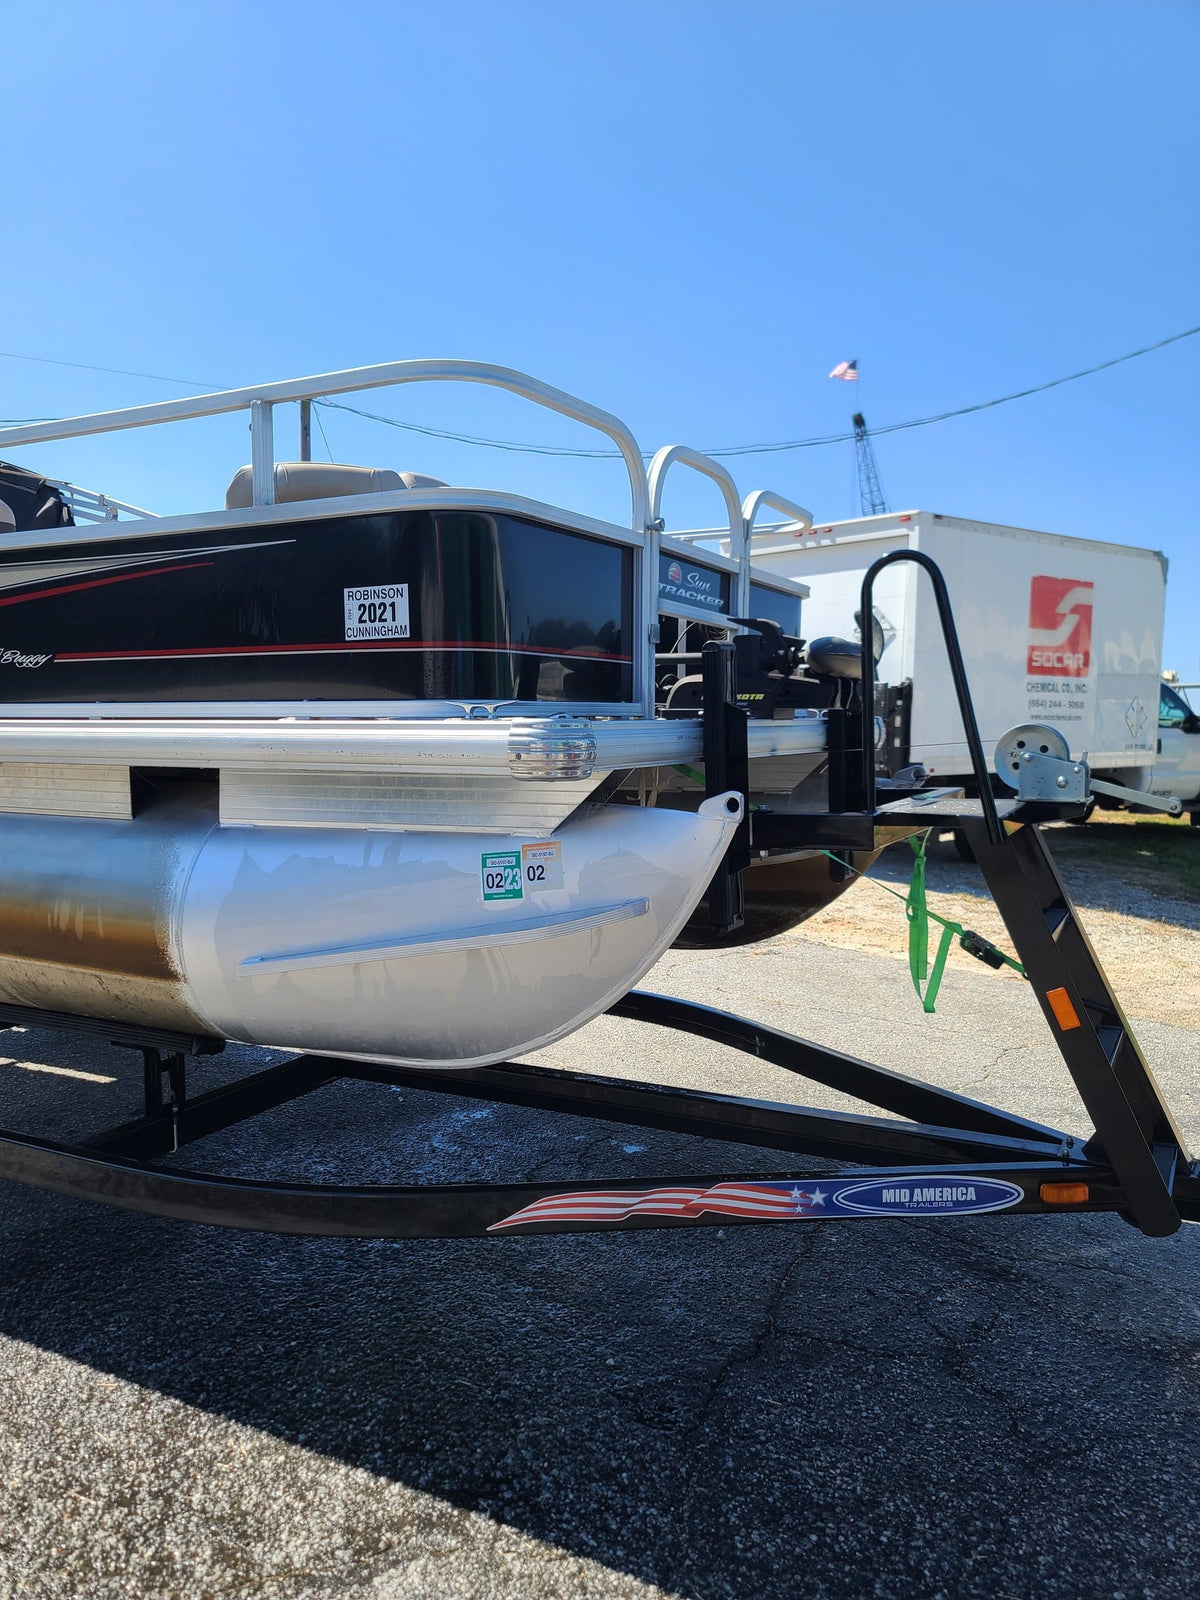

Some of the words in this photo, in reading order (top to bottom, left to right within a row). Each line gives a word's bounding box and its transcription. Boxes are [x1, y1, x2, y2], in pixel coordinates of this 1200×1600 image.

[685, 572, 713, 592] Sun
[347, 587, 404, 601] ROBINSON
[658, 583, 724, 606] TRACKER
[357, 601, 396, 624] 2021
[346, 625, 408, 638] CUNNINGHAM
[0, 650, 53, 668] Buggy
[1031, 651, 1084, 668] SOCAR
[1026, 682, 1059, 693] CHEMICAL
[1074, 683, 1088, 694] INC.
[1048, 700, 1062, 708] 244
[486, 873, 504, 889] 02
[504, 868, 522, 890] 23
[527, 865, 546, 882] 02
[882, 1189, 910, 1203] MID
[912, 1187, 977, 1202] AMERICA
